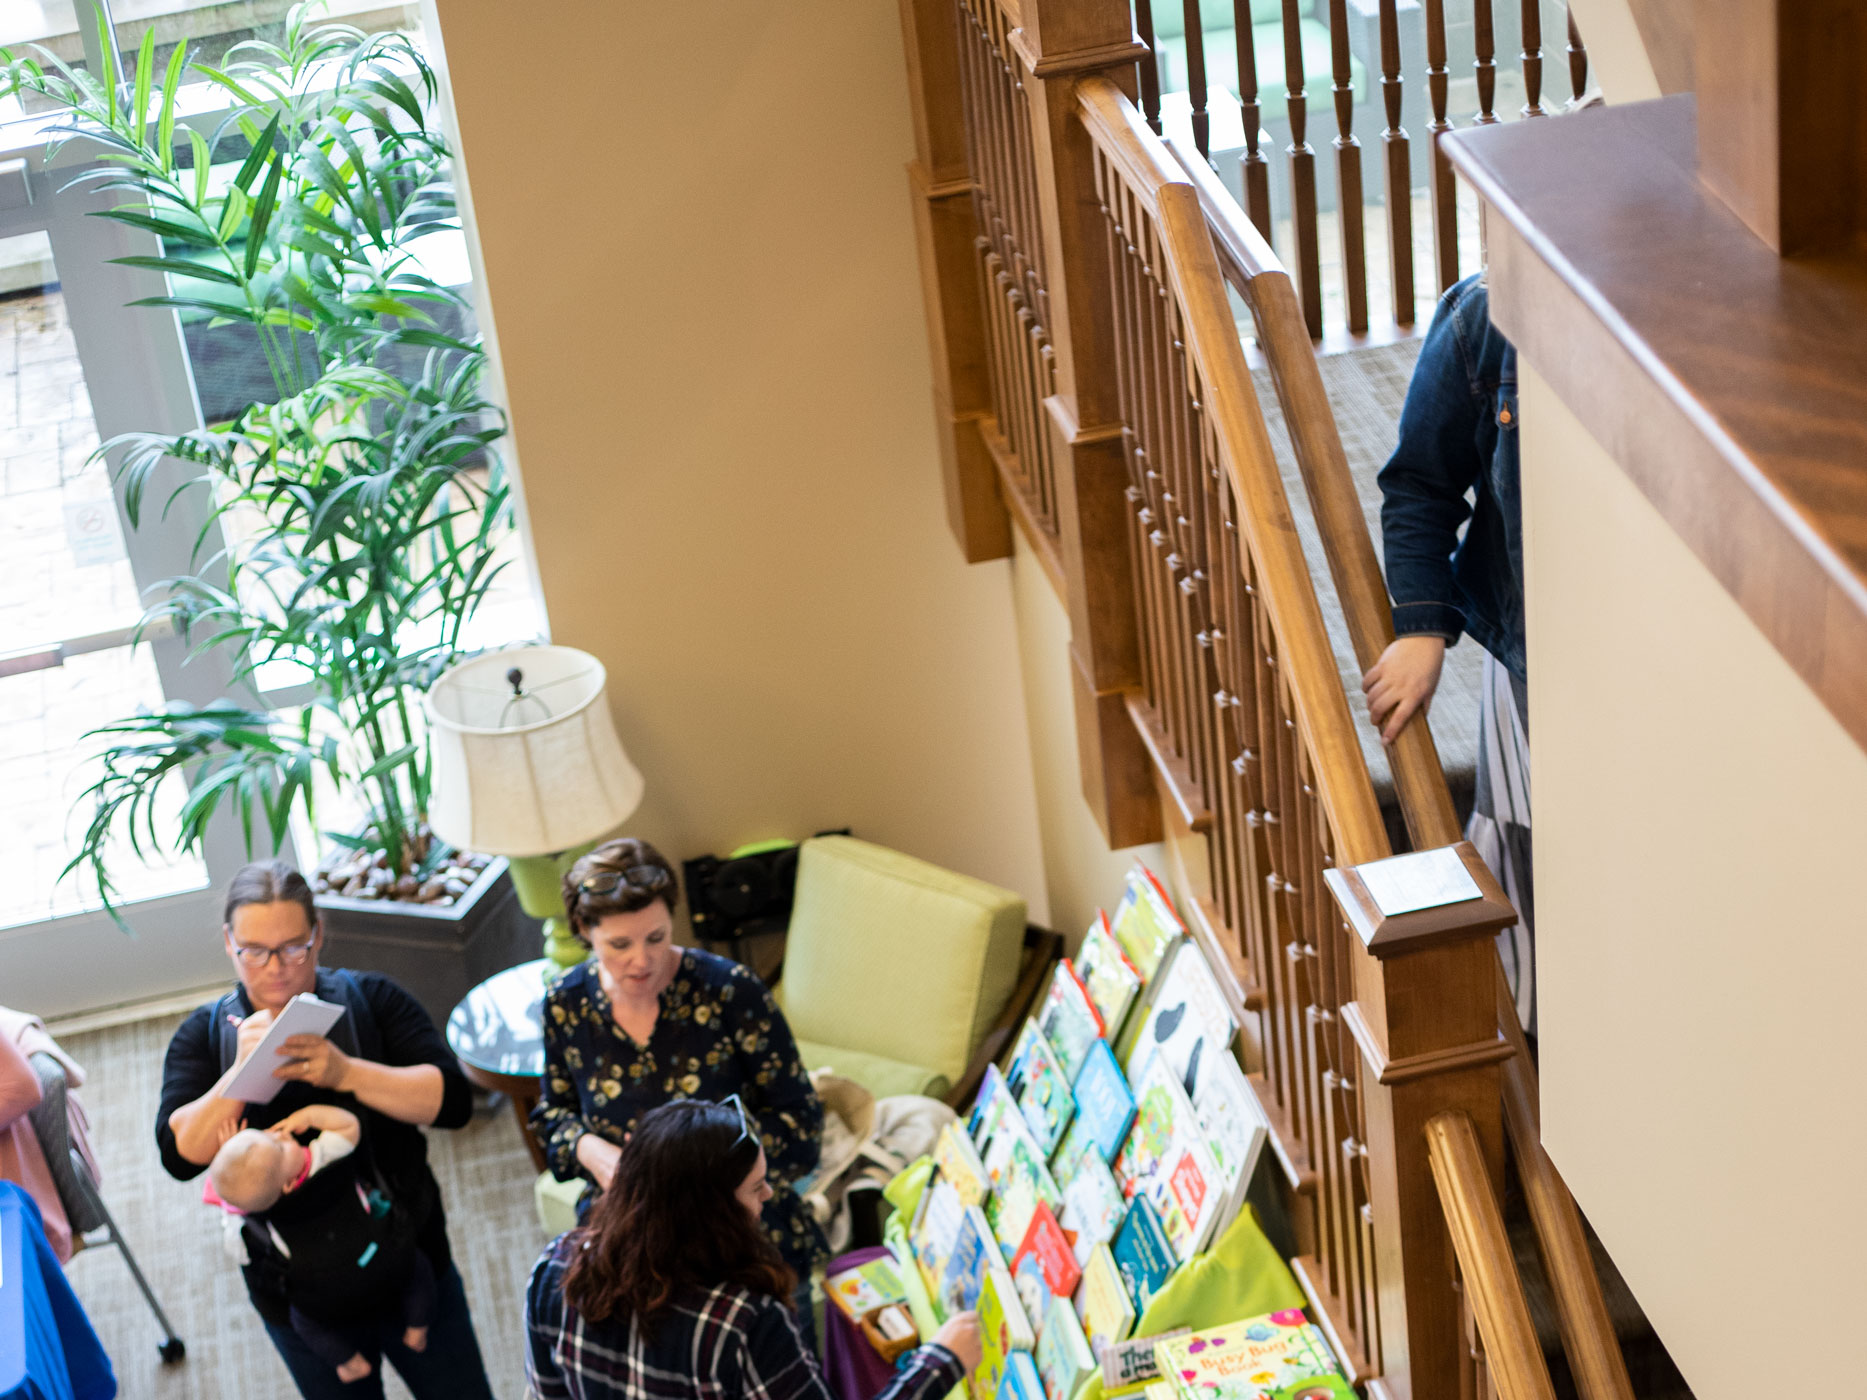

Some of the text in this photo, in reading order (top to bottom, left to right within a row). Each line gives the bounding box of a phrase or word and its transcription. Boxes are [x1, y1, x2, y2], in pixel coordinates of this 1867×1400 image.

[1200, 1341, 1288, 1371] Busy Bug
[1217, 1359, 1263, 1377] Book
